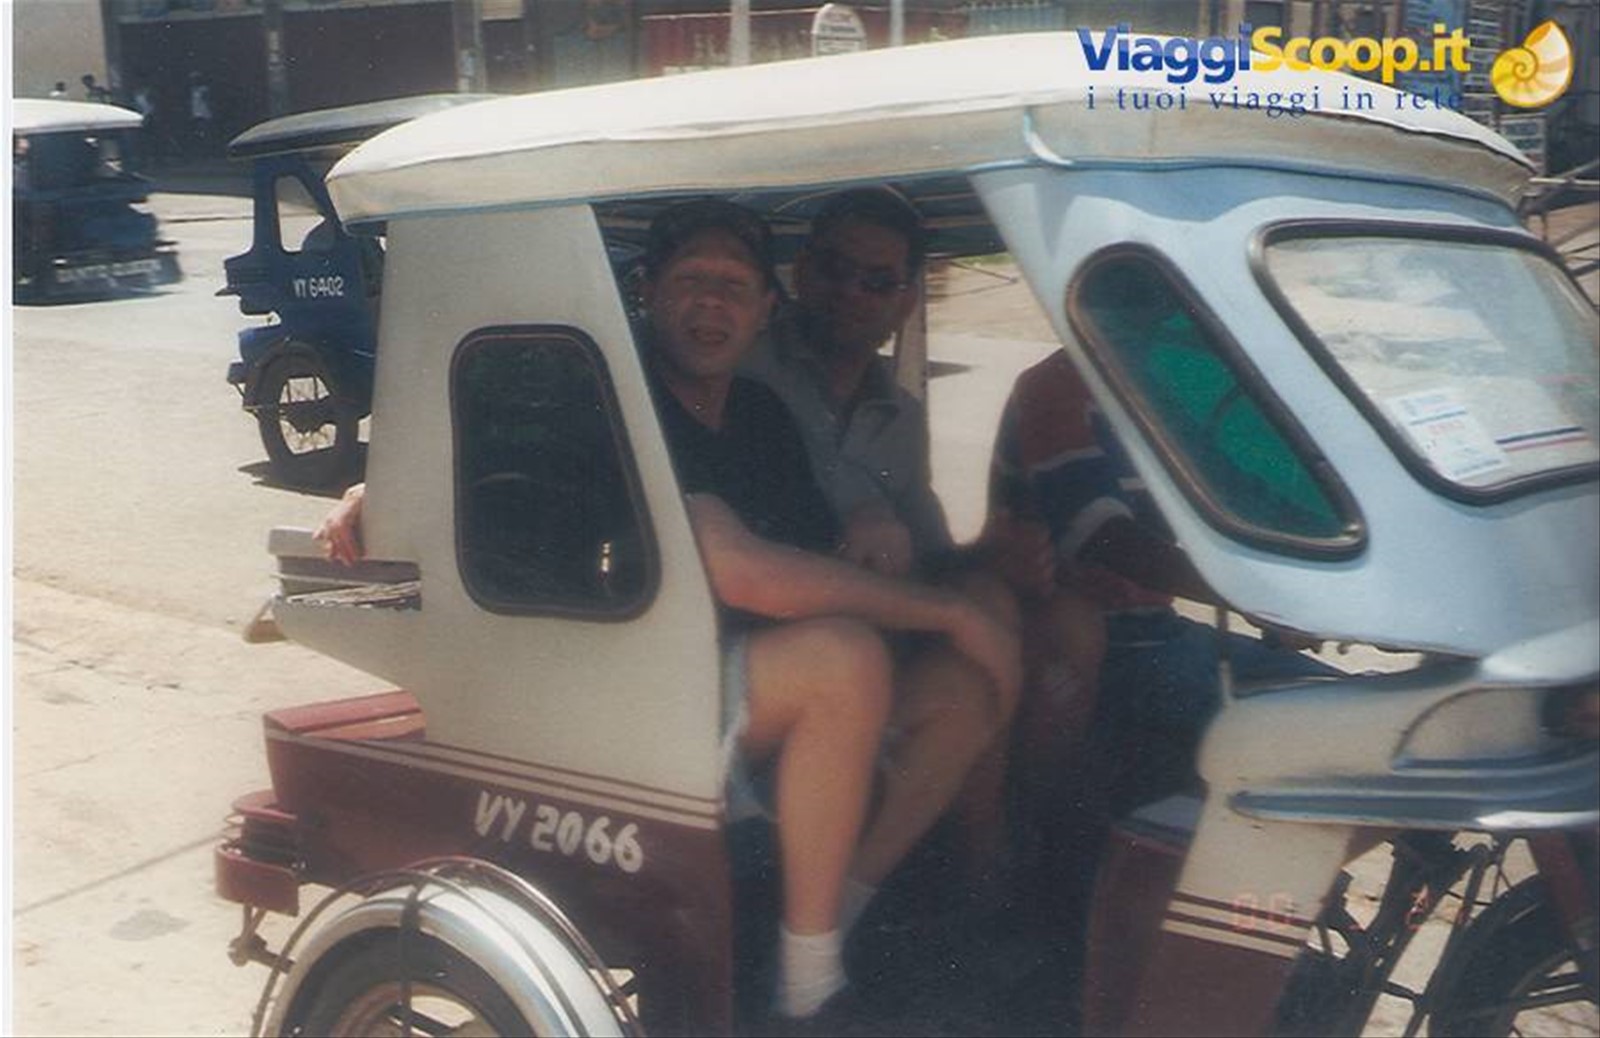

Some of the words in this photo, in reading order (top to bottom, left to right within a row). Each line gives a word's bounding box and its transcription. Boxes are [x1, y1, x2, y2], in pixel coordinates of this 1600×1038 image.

[309, 275, 344, 298] 6402
[474, 790, 526, 842] VY
[530, 804, 644, 874] 2066
